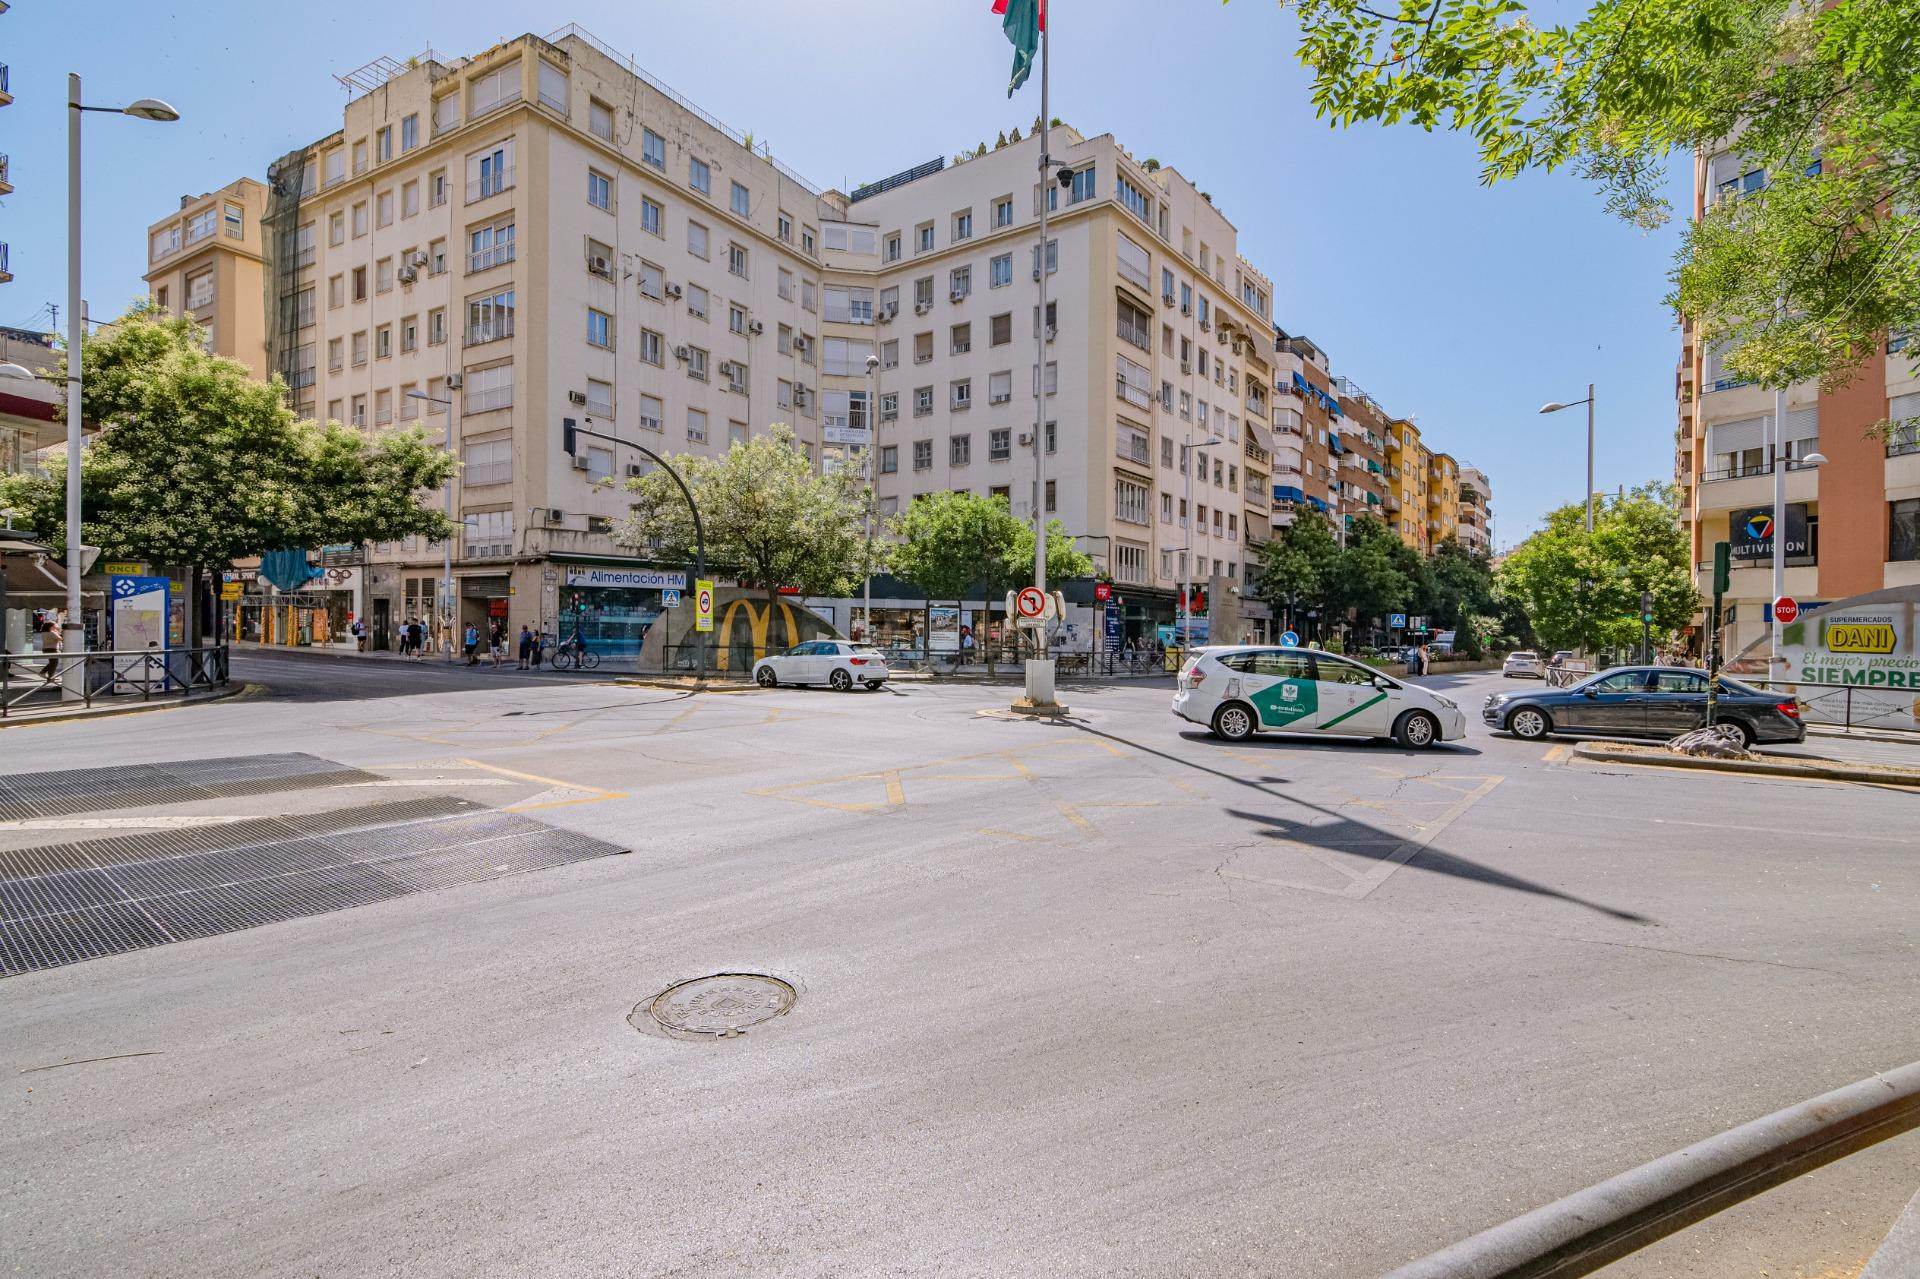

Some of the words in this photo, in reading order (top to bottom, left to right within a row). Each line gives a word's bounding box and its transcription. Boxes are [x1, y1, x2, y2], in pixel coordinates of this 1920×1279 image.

[1730, 541, 1805, 555] MULTIVISON
[108, 565, 138, 573] ONCE
[590, 570, 665, 585] Alimentación
[667, 574, 685, 586] HM
[1776, 606, 1796, 614] STOP
[1832, 626, 1889, 649] DANI
[1803, 652, 1817, 665] El
[1820, 654, 1864, 671] mejor
[1868, 655, 1920, 671] precio
[1801, 667, 1920, 688] SIEMPRE
